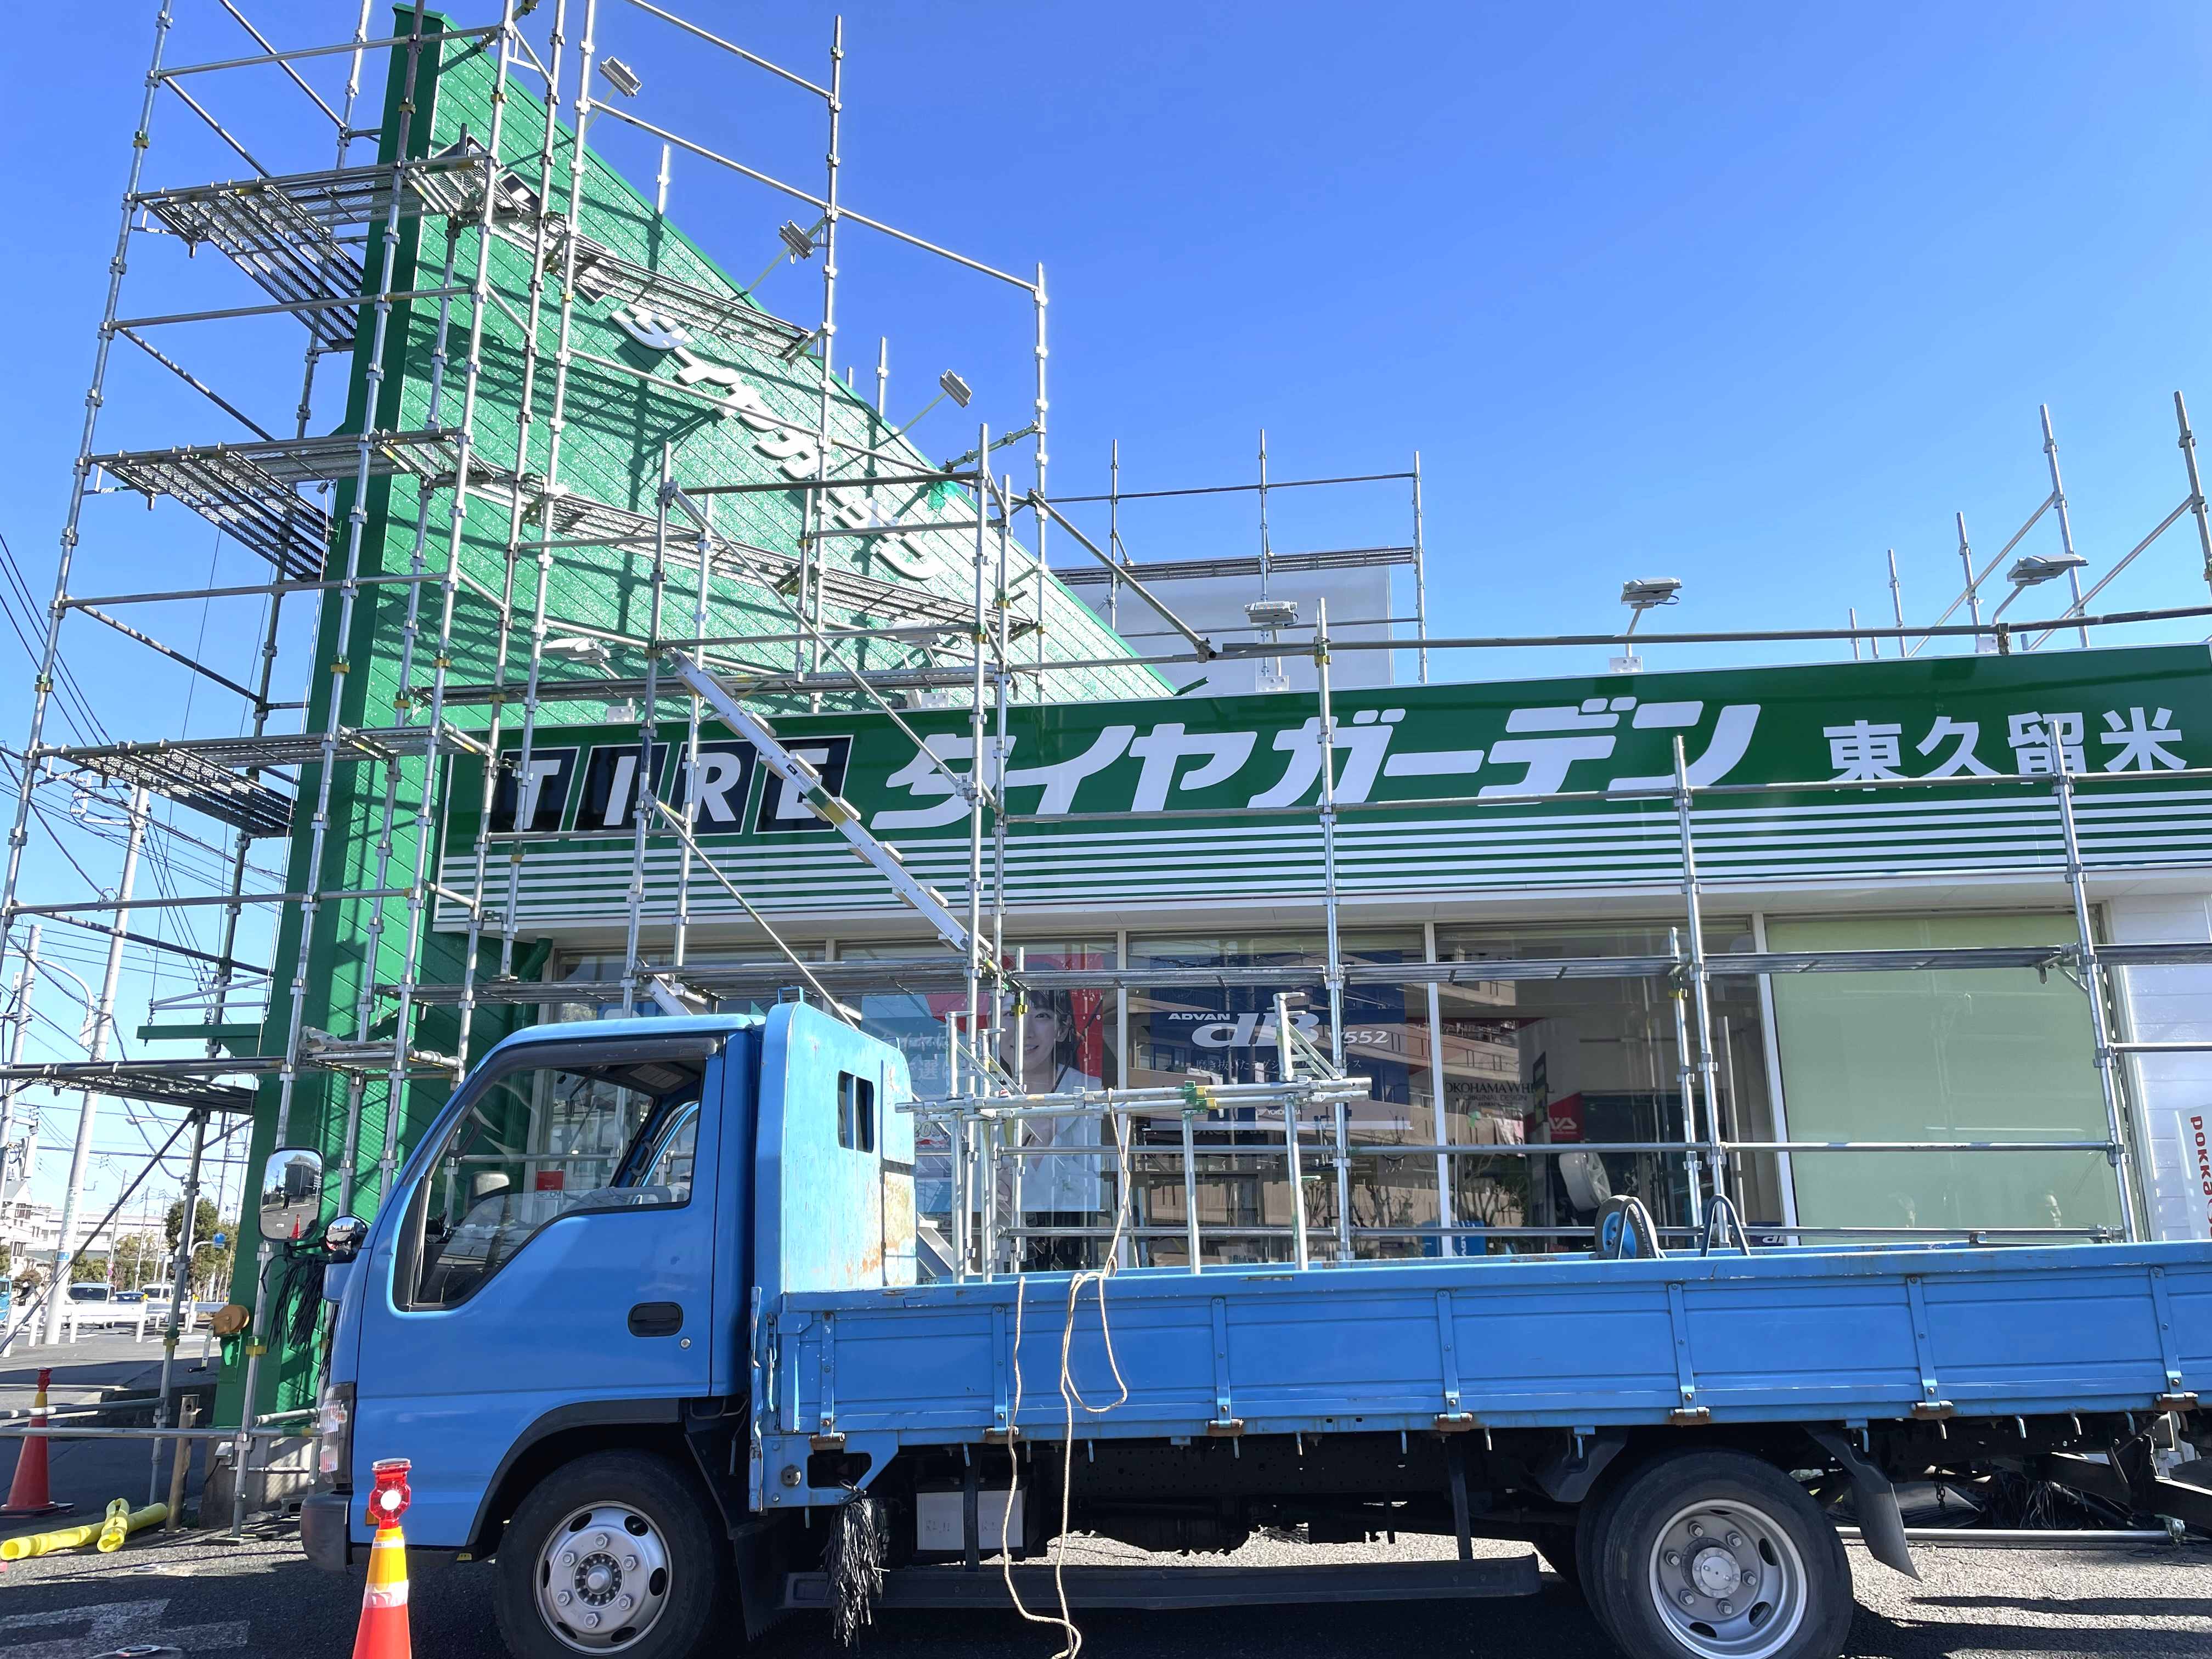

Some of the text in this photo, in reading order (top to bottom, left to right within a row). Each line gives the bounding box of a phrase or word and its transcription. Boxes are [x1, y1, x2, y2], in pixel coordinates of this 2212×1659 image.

[513, 748, 830, 829] TIRE
[870, 696, 2187, 830] タイヤガーデン 東久留米
[1192, 1013, 1319, 1048] dB
[1444, 1082, 1506, 1093] OKOHAMA
